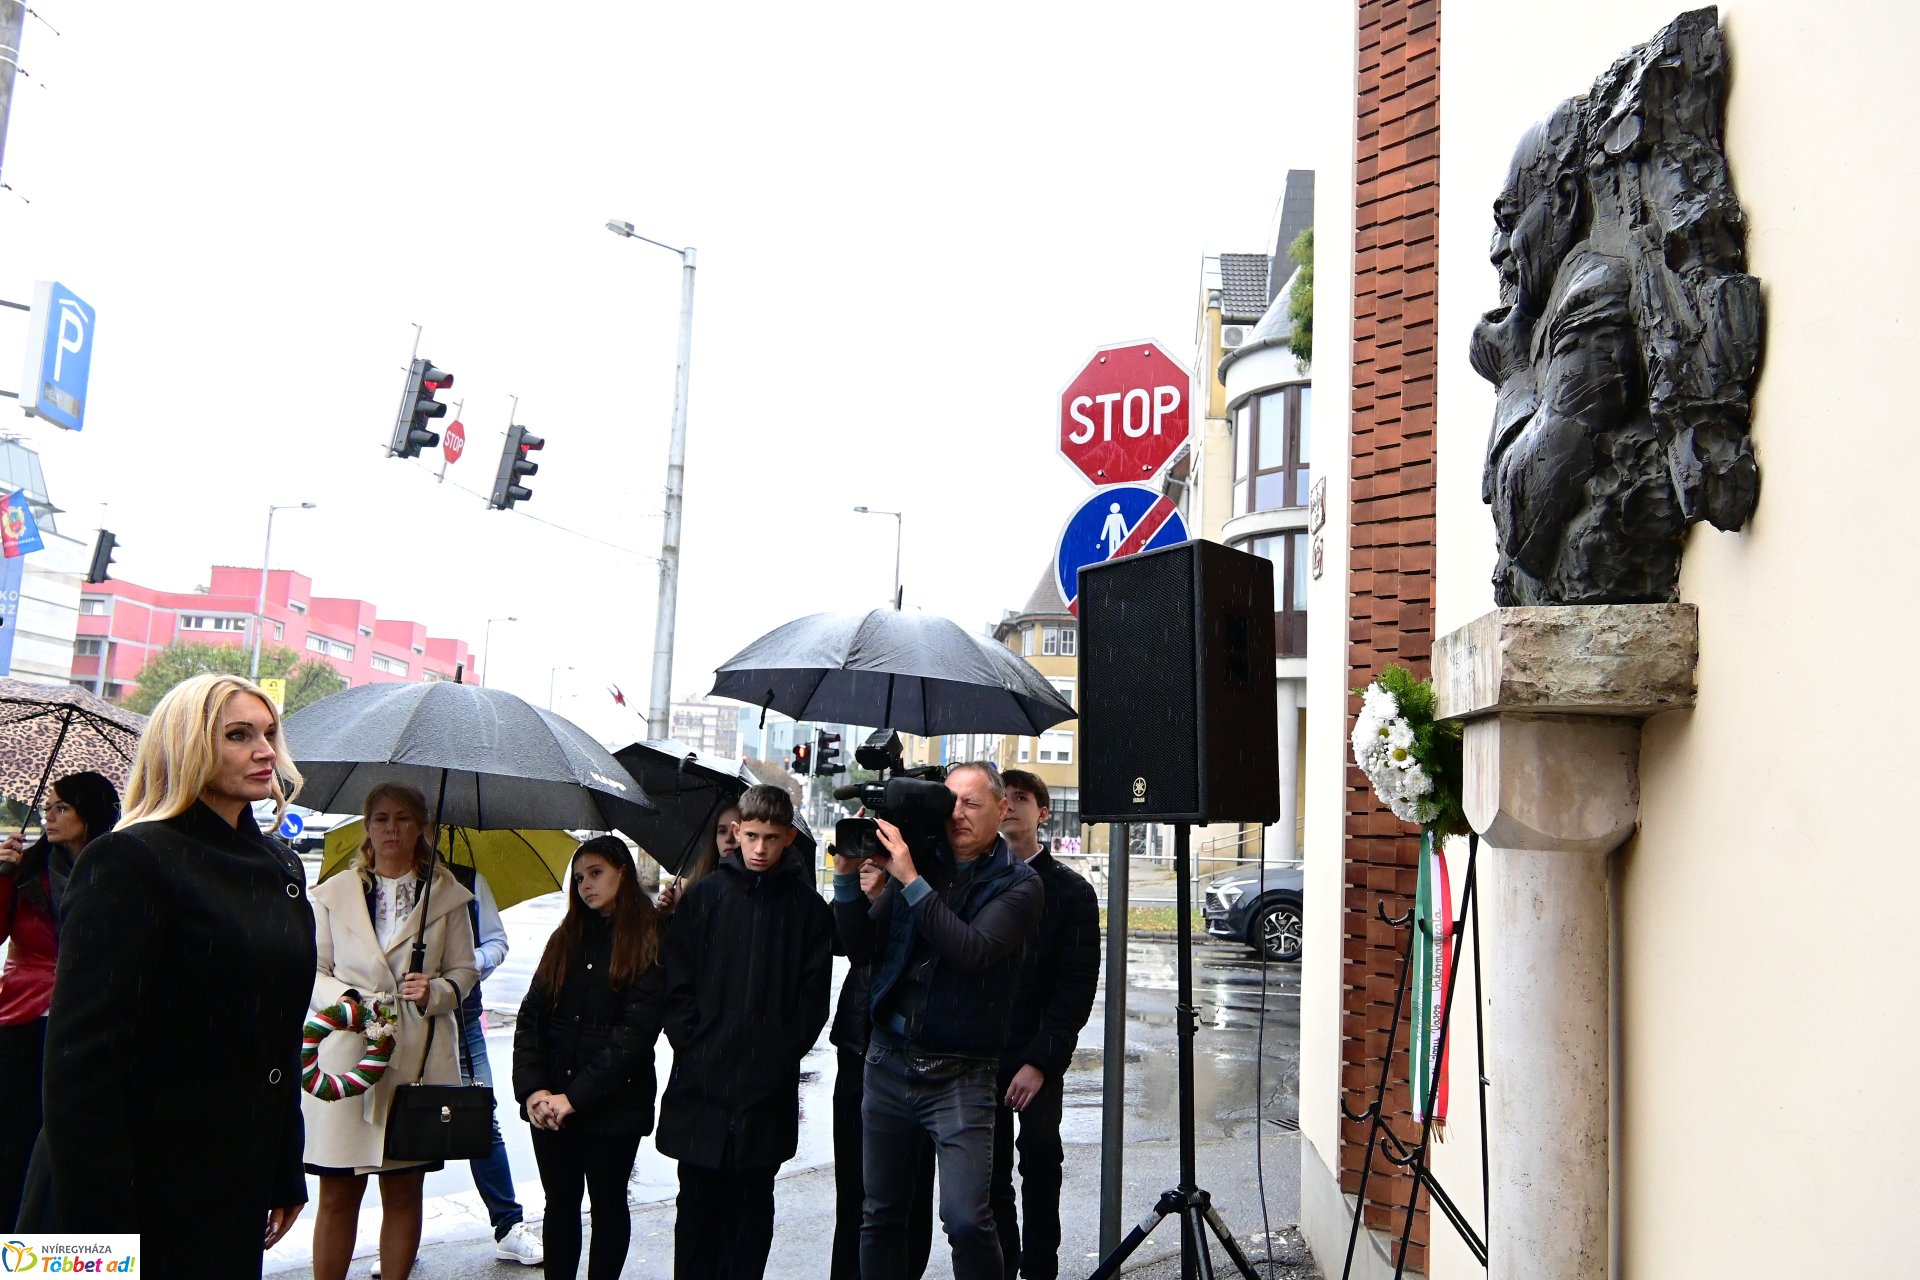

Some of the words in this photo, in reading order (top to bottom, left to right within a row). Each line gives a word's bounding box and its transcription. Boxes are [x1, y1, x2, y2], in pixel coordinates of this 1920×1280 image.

[53, 306, 84, 382] P
[444, 430, 464, 453] STOP
[1068, 385, 1181, 445] STOP
